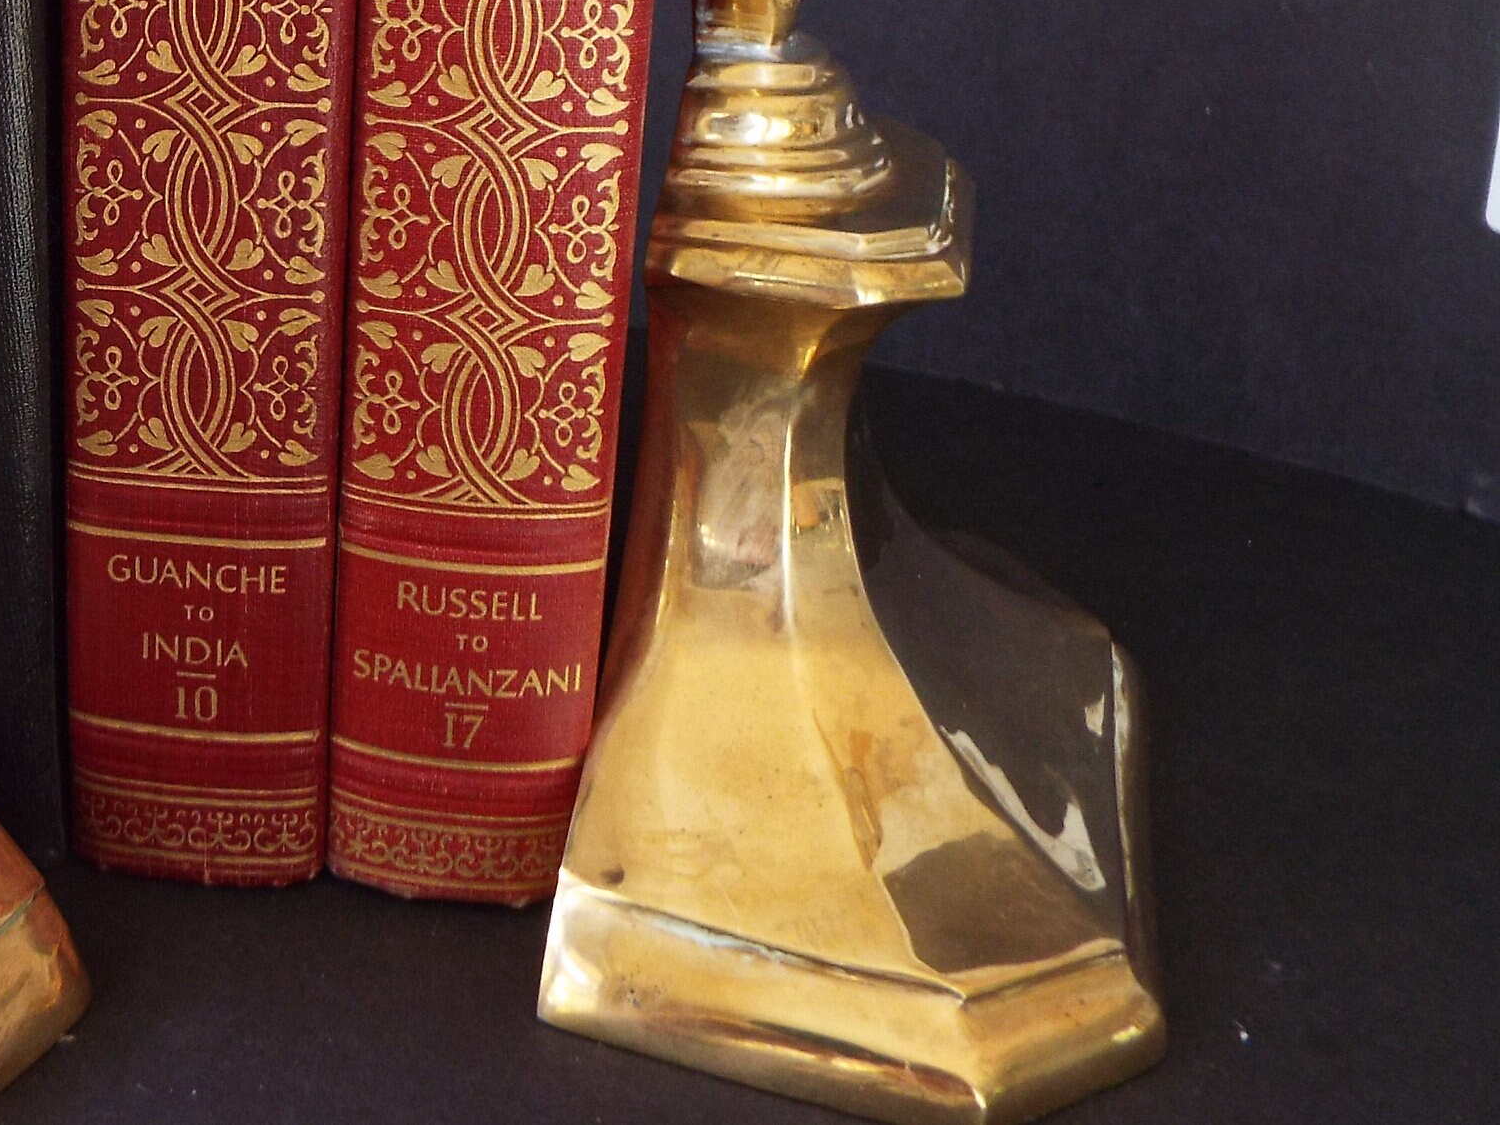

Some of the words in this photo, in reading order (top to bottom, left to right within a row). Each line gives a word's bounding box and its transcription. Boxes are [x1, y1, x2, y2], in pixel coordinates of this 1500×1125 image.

[108, 555, 286, 593] GUANCHE
[184, 605, 213, 621] TO
[398, 581, 542, 621] RUSSELL
[143, 632, 248, 668] INDIA
[456, 634, 488, 652] TO
[353, 648, 582, 699] SPALLANZANI
[176, 686, 217, 721] 10
[444, 713, 484, 749] 17
